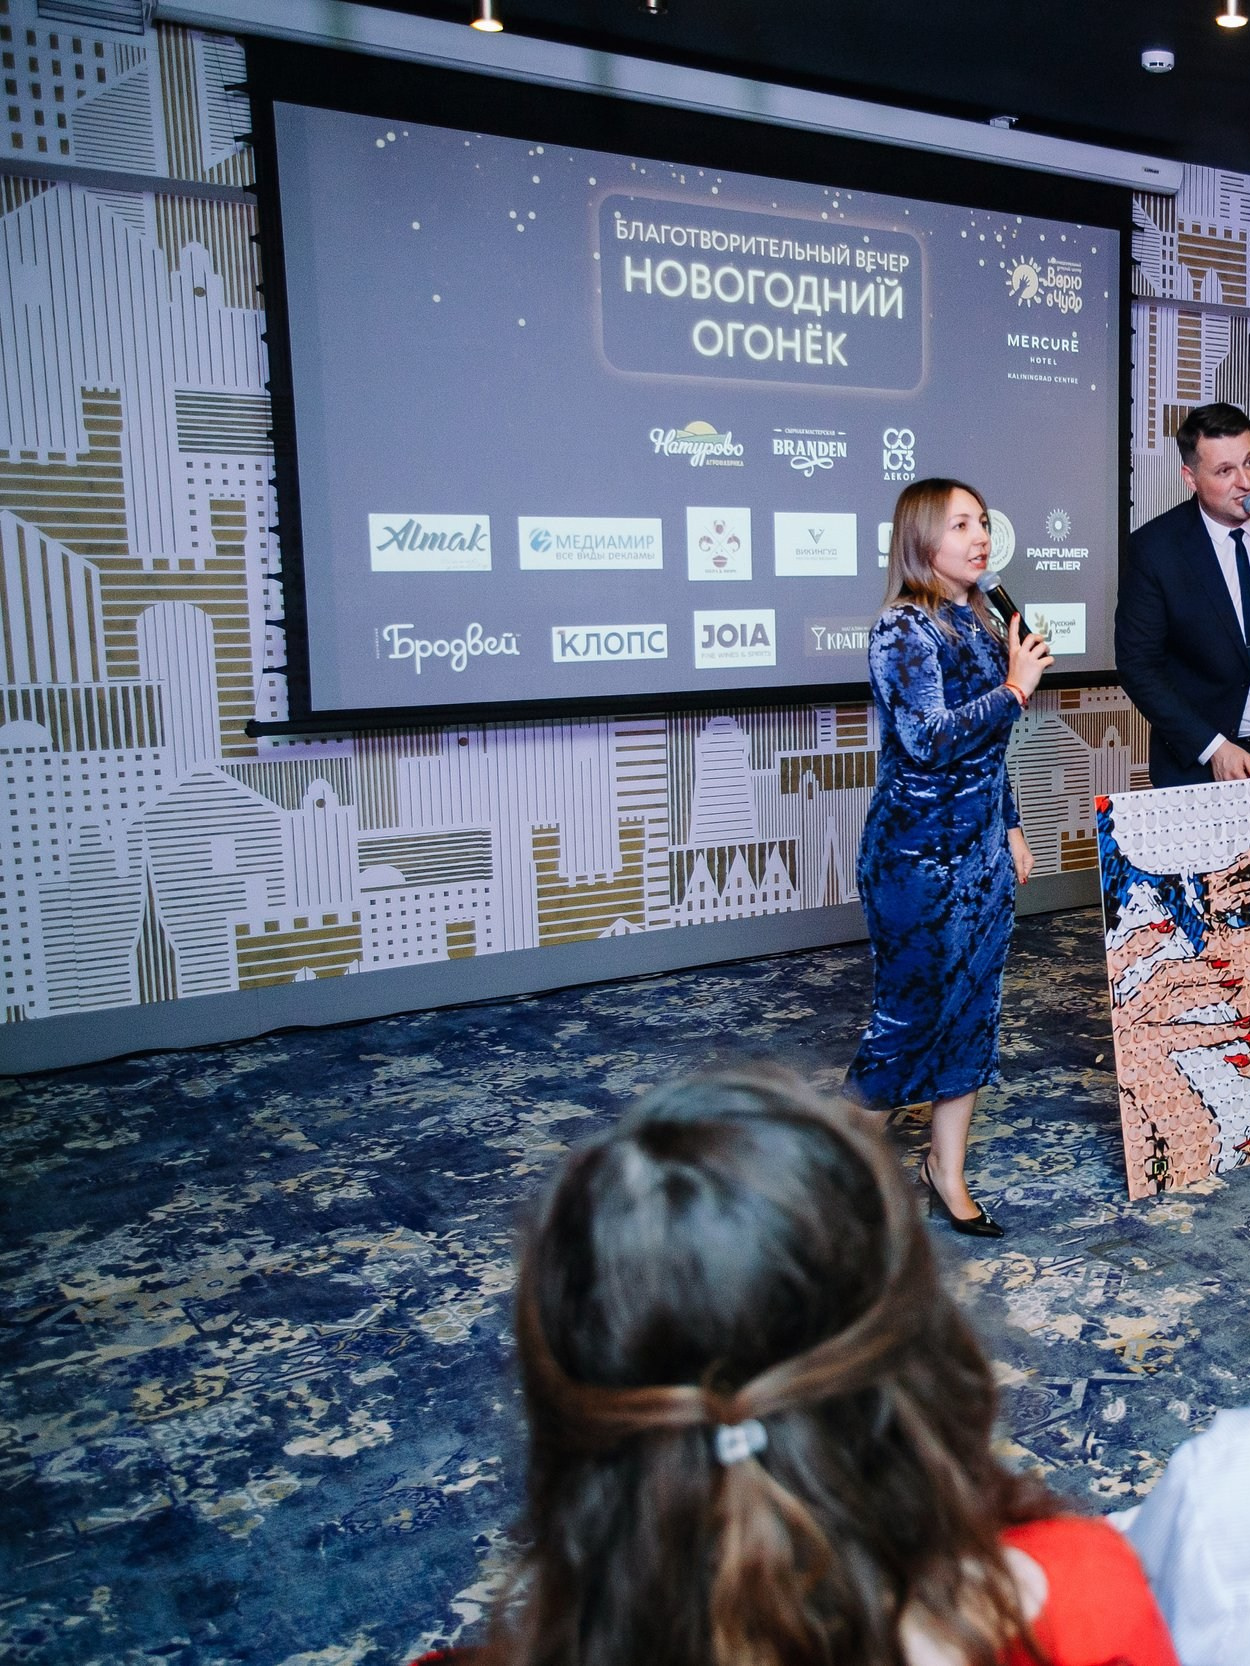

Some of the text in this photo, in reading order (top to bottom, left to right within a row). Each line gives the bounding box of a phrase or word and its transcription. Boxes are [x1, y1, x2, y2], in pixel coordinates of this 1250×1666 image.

[615, 219, 910, 272] БЛАГОТВОРИТЕЛЬНЫЙ ВЕЧЕР
[624, 255, 904, 320] НОВОГОДНИЙ
[1047, 266, 1083, 293] Верю
[692, 319, 848, 367] ОГОНЁК
[1007, 333, 1079, 352] MERCURE
[1030, 356, 1057, 366] HOTEL
[1007, 372, 1079, 385] KALININGRAD CENTRE
[649, 427, 744, 467] Натурово
[772, 439, 848, 460] BRANDEN
[883, 472, 916, 481] ДЕКОР
[376, 518, 489, 552] Almak
[555, 533, 655, 552] МЕДИАМИР
[555, 551, 656, 561] все виды рекламы
[1026, 547, 1089, 558] PARFUMER
[1035, 560, 1081, 571] ATELIER
[701, 623, 771, 649] JOIA
[383, 622, 520, 674] Бродвей
